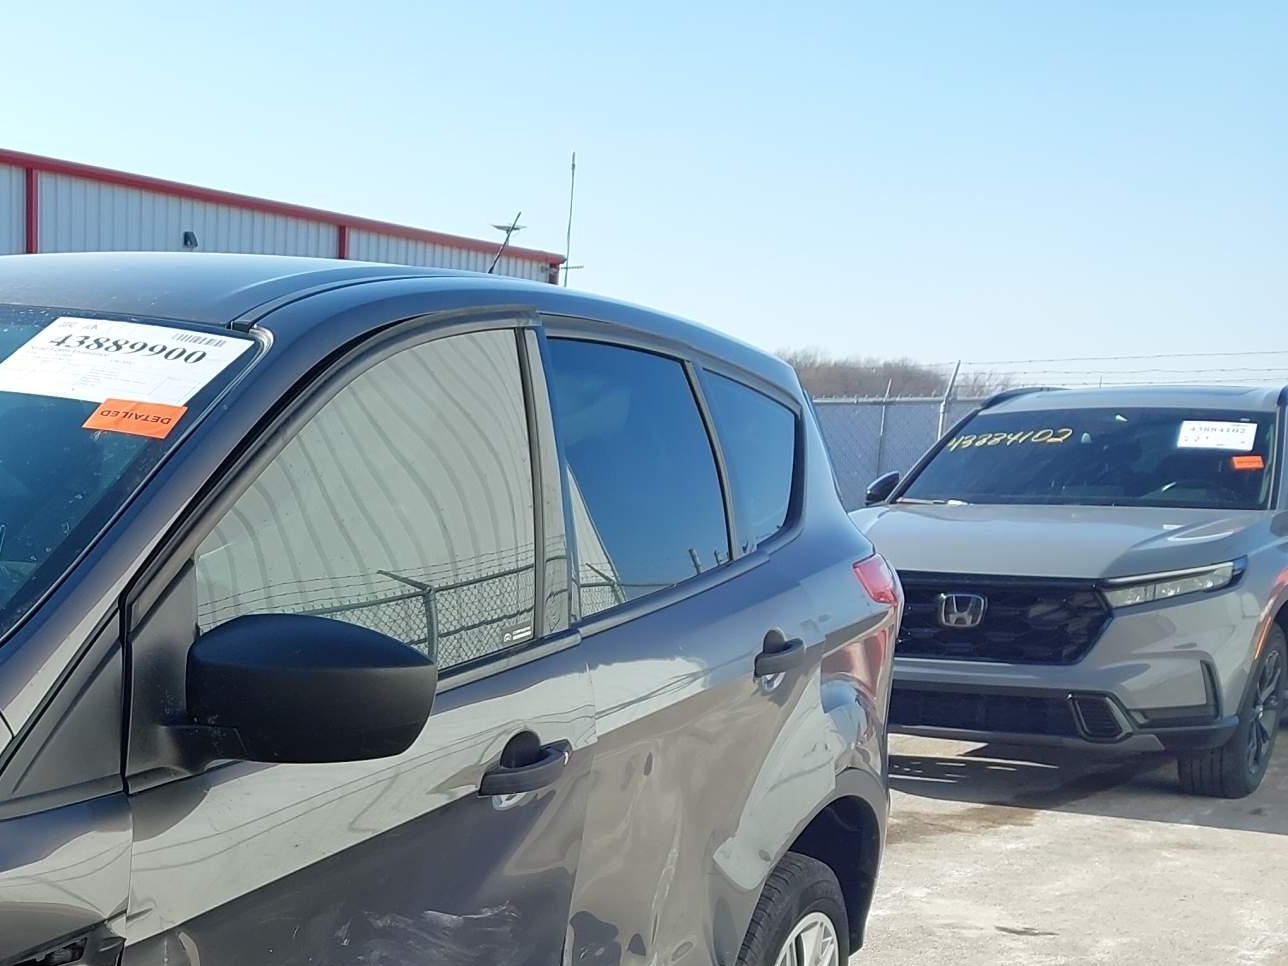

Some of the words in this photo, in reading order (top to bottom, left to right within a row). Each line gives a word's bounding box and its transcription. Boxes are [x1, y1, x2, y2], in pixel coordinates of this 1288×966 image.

[49, 333, 208, 364] 43889900
[100, 409, 172, 425] DETAILED
[946, 427, 1073, 452] 43884102
